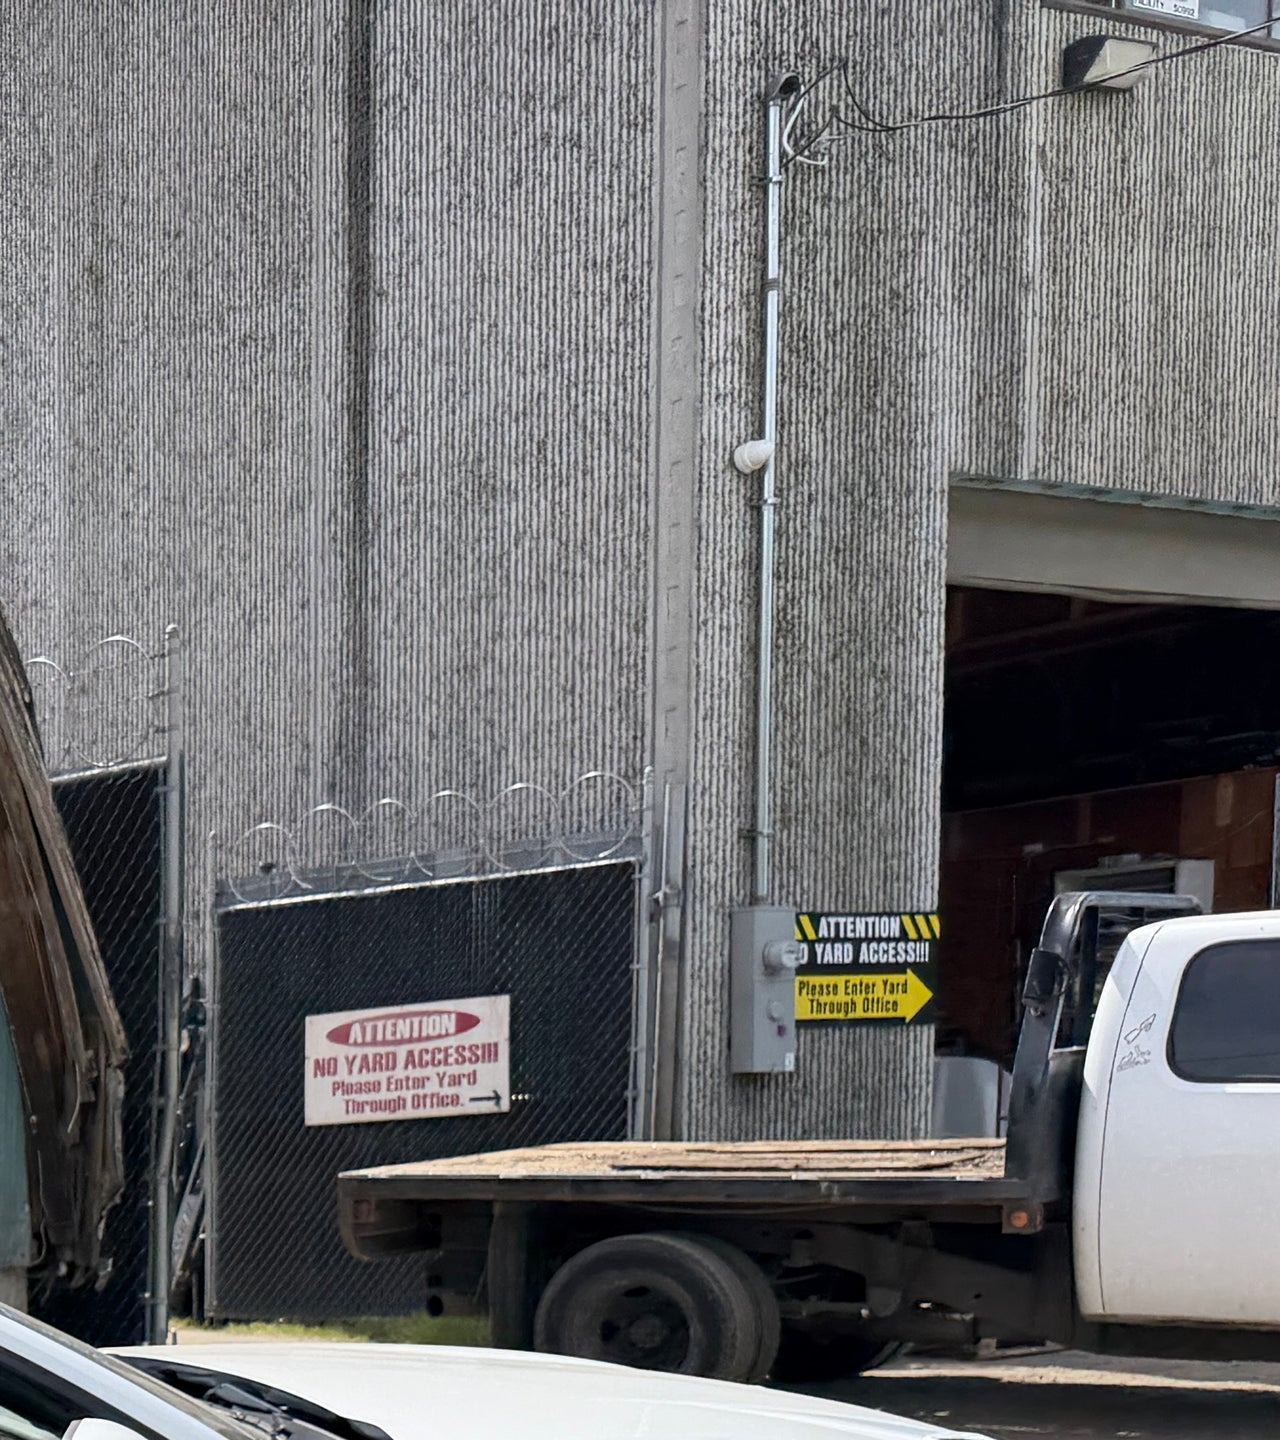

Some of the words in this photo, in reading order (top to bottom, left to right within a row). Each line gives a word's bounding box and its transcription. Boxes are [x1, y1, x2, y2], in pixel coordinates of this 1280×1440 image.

[819, 916, 900, 939] ATTENTION
[815, 942, 854, 965] YARD
[859, 941, 930, 964] ACCESS!!!
[798, 980, 839, 997] Please
[845, 979, 877, 996] Enter
[882, 979, 908, 995] Yard
[809, 997, 857, 1017] Through
[862, 997, 899, 1013] Office
[348, 1013, 457, 1044] ATTENTION
[313, 1057, 338, 1078] NO
[344, 1051, 398, 1076] YARD
[404, 1042, 499, 1070] ACCESS!!!
[332, 1079, 382, 1097] Please
[386, 1075, 430, 1092] Enter
[436, 1069, 477, 1088] Yard
[344, 1096, 407, 1115] Through
[411, 1091, 465, 1110] Office.
